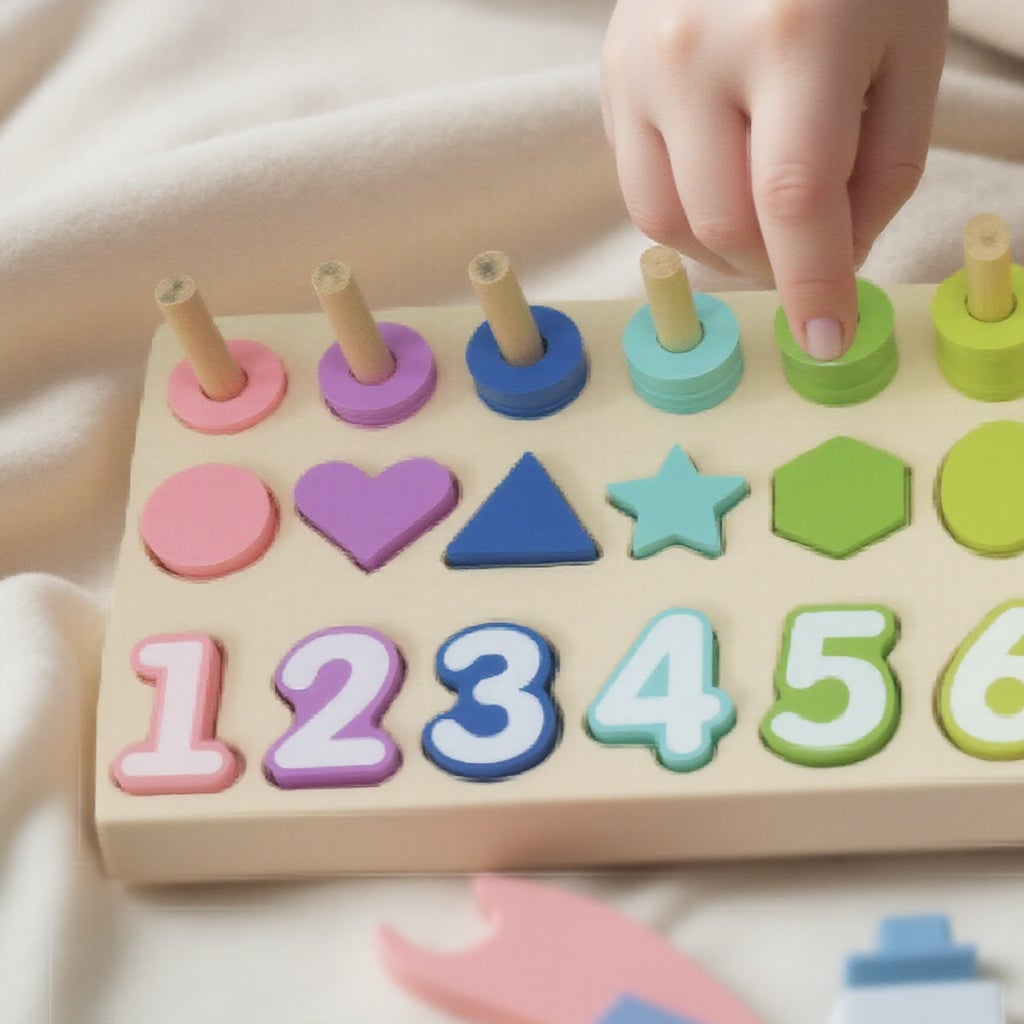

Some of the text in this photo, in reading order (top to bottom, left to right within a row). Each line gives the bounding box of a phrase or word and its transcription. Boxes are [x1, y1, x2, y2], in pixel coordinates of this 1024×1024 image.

[118, 639, 226, 776] 1
[272, 629, 388, 771] 2
[429, 625, 546, 766] 3
[593, 612, 723, 757] 4
[768, 608, 888, 749] 5
